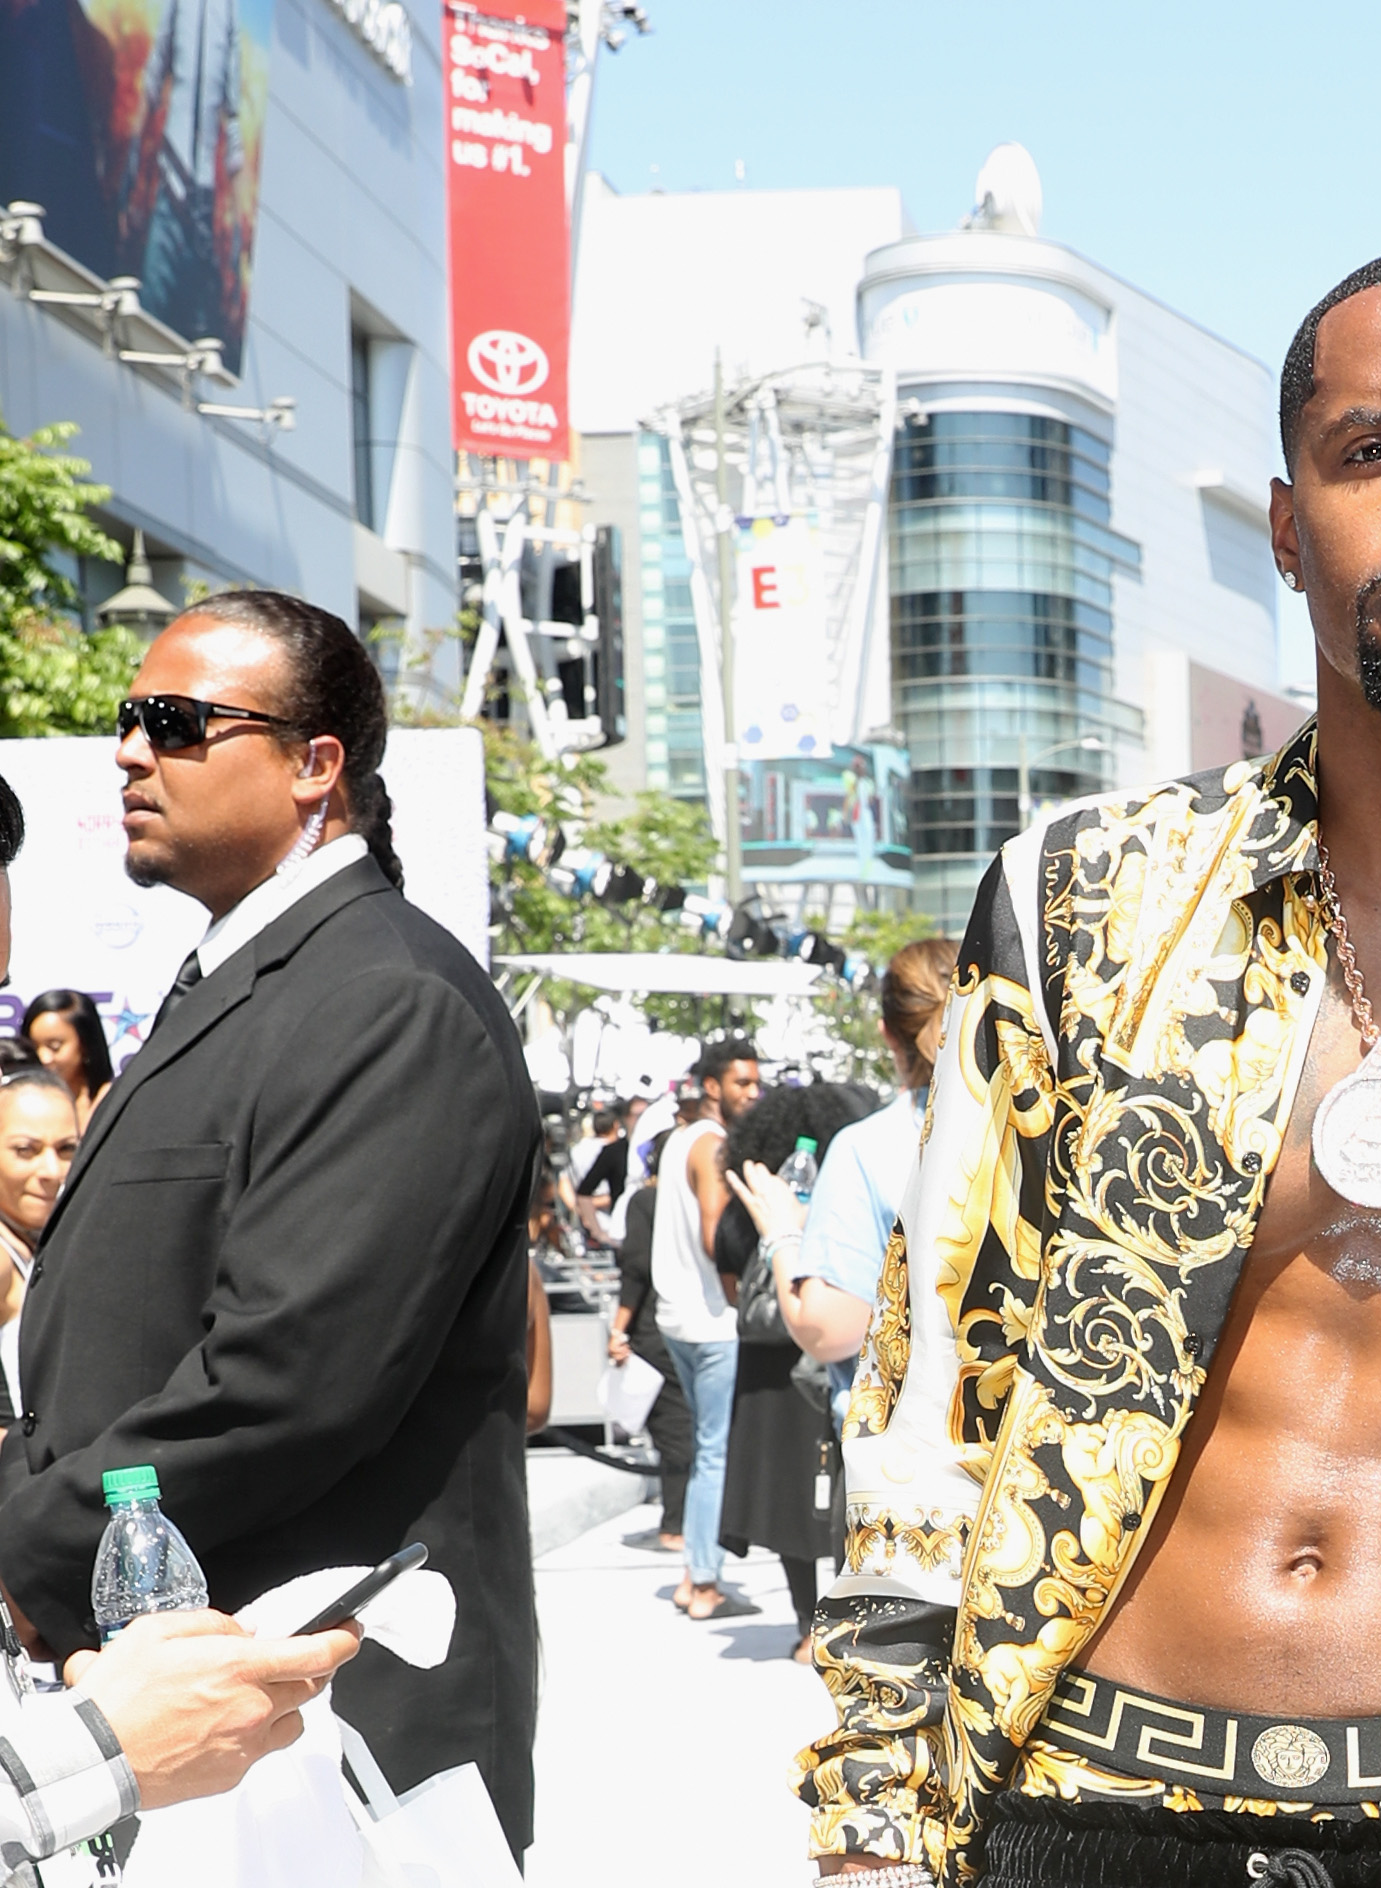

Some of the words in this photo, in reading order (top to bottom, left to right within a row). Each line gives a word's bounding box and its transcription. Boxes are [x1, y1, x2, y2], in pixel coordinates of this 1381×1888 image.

[451, 106, 553, 154] making
[451, 139, 489, 169] us
[461, 391, 558, 428] TOYOTA
